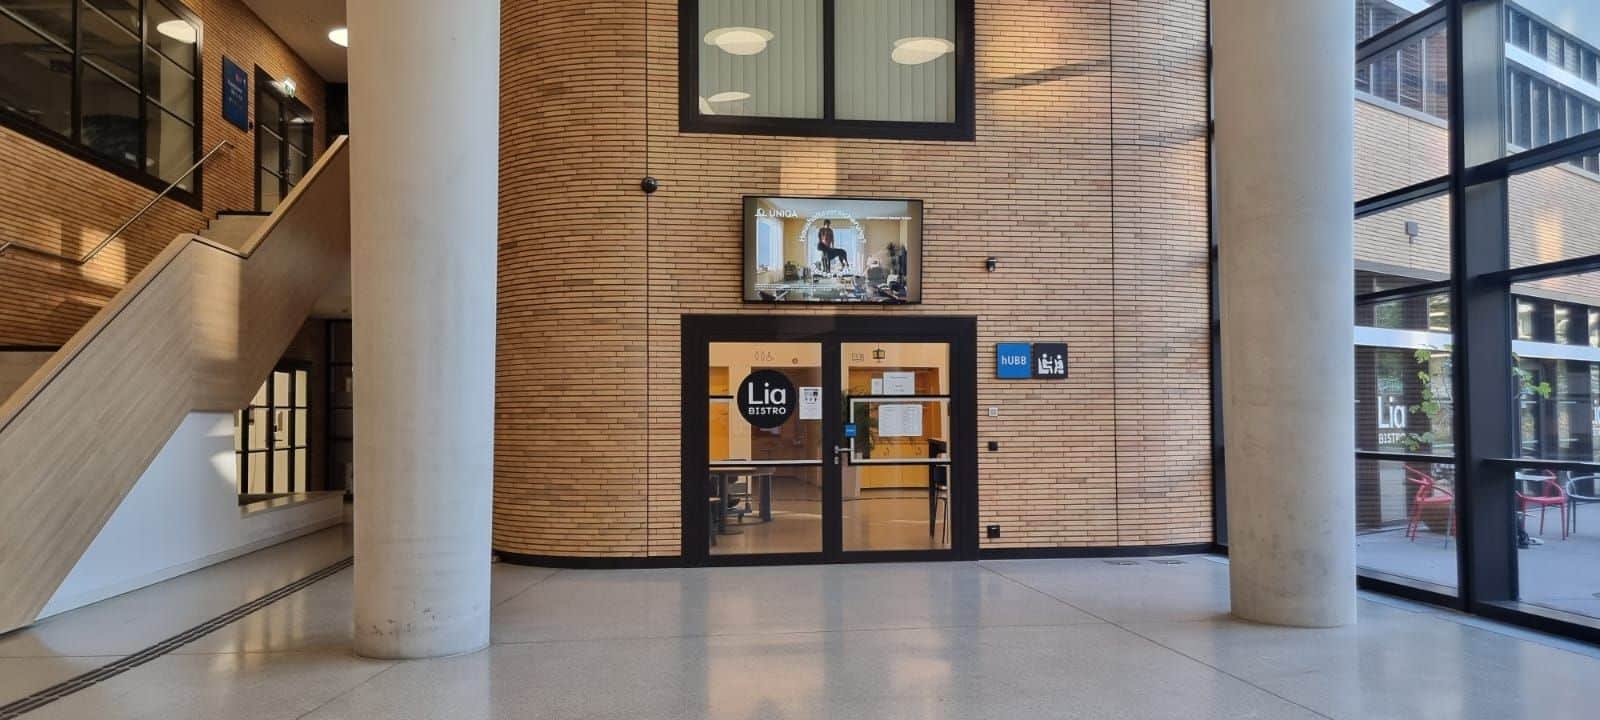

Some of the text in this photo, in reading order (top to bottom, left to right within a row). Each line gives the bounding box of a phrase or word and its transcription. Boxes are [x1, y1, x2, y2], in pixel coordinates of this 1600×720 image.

[769, 208, 799, 218] UNIQA
[1001, 355, 1027, 366] hUBB
[748, 382, 786, 405] Lia
[748, 407, 787, 415] BISTRO
[1378, 395, 1406, 428] Lia
